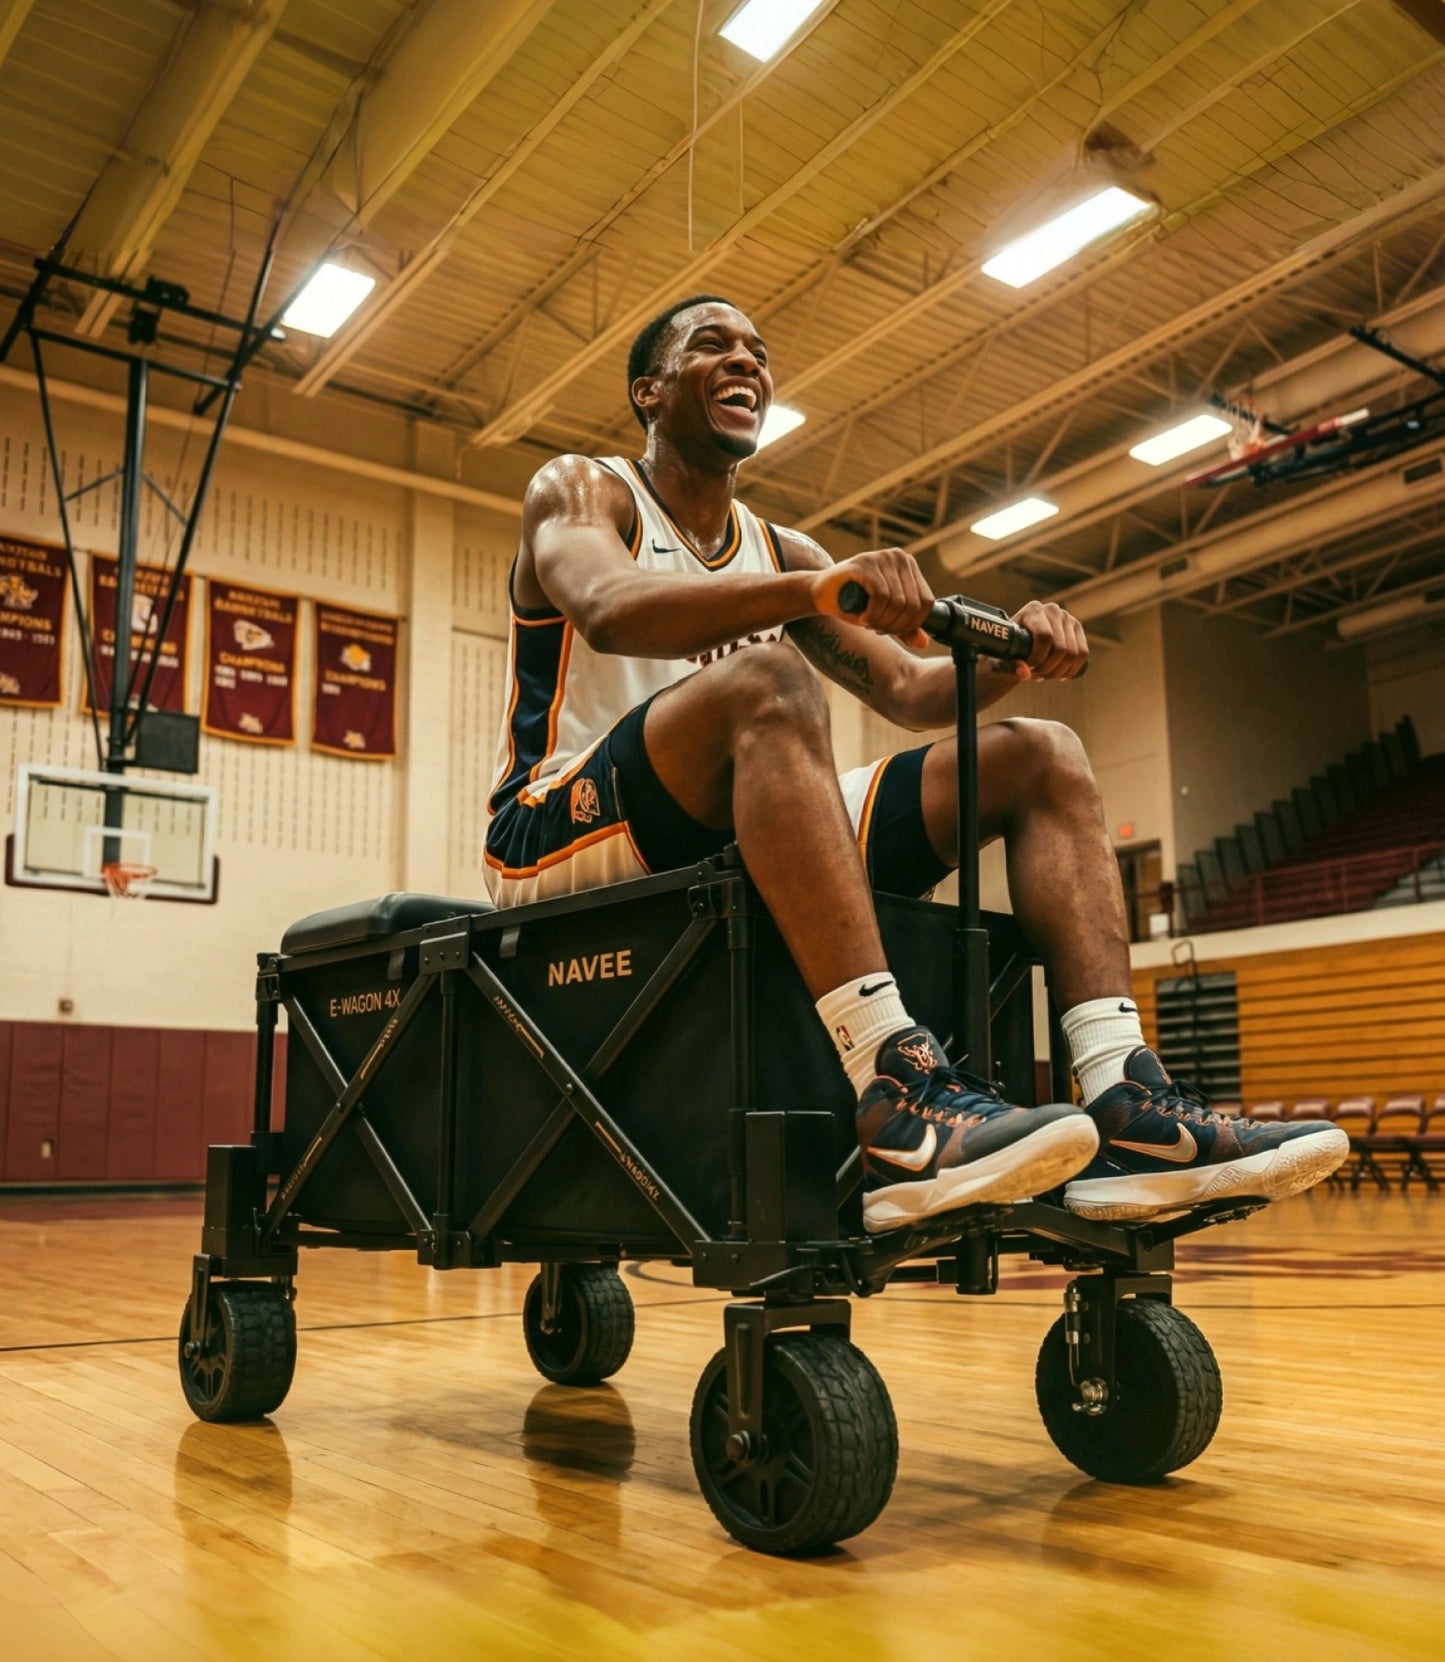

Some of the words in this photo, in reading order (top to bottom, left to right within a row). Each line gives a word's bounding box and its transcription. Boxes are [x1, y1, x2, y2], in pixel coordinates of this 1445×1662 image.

[971, 616, 1009, 640] NAVEE
[548, 949, 632, 987] NAVEE
[330, 991, 382, 1017] E-WAGON
[384, 988, 400, 1008] 4X
